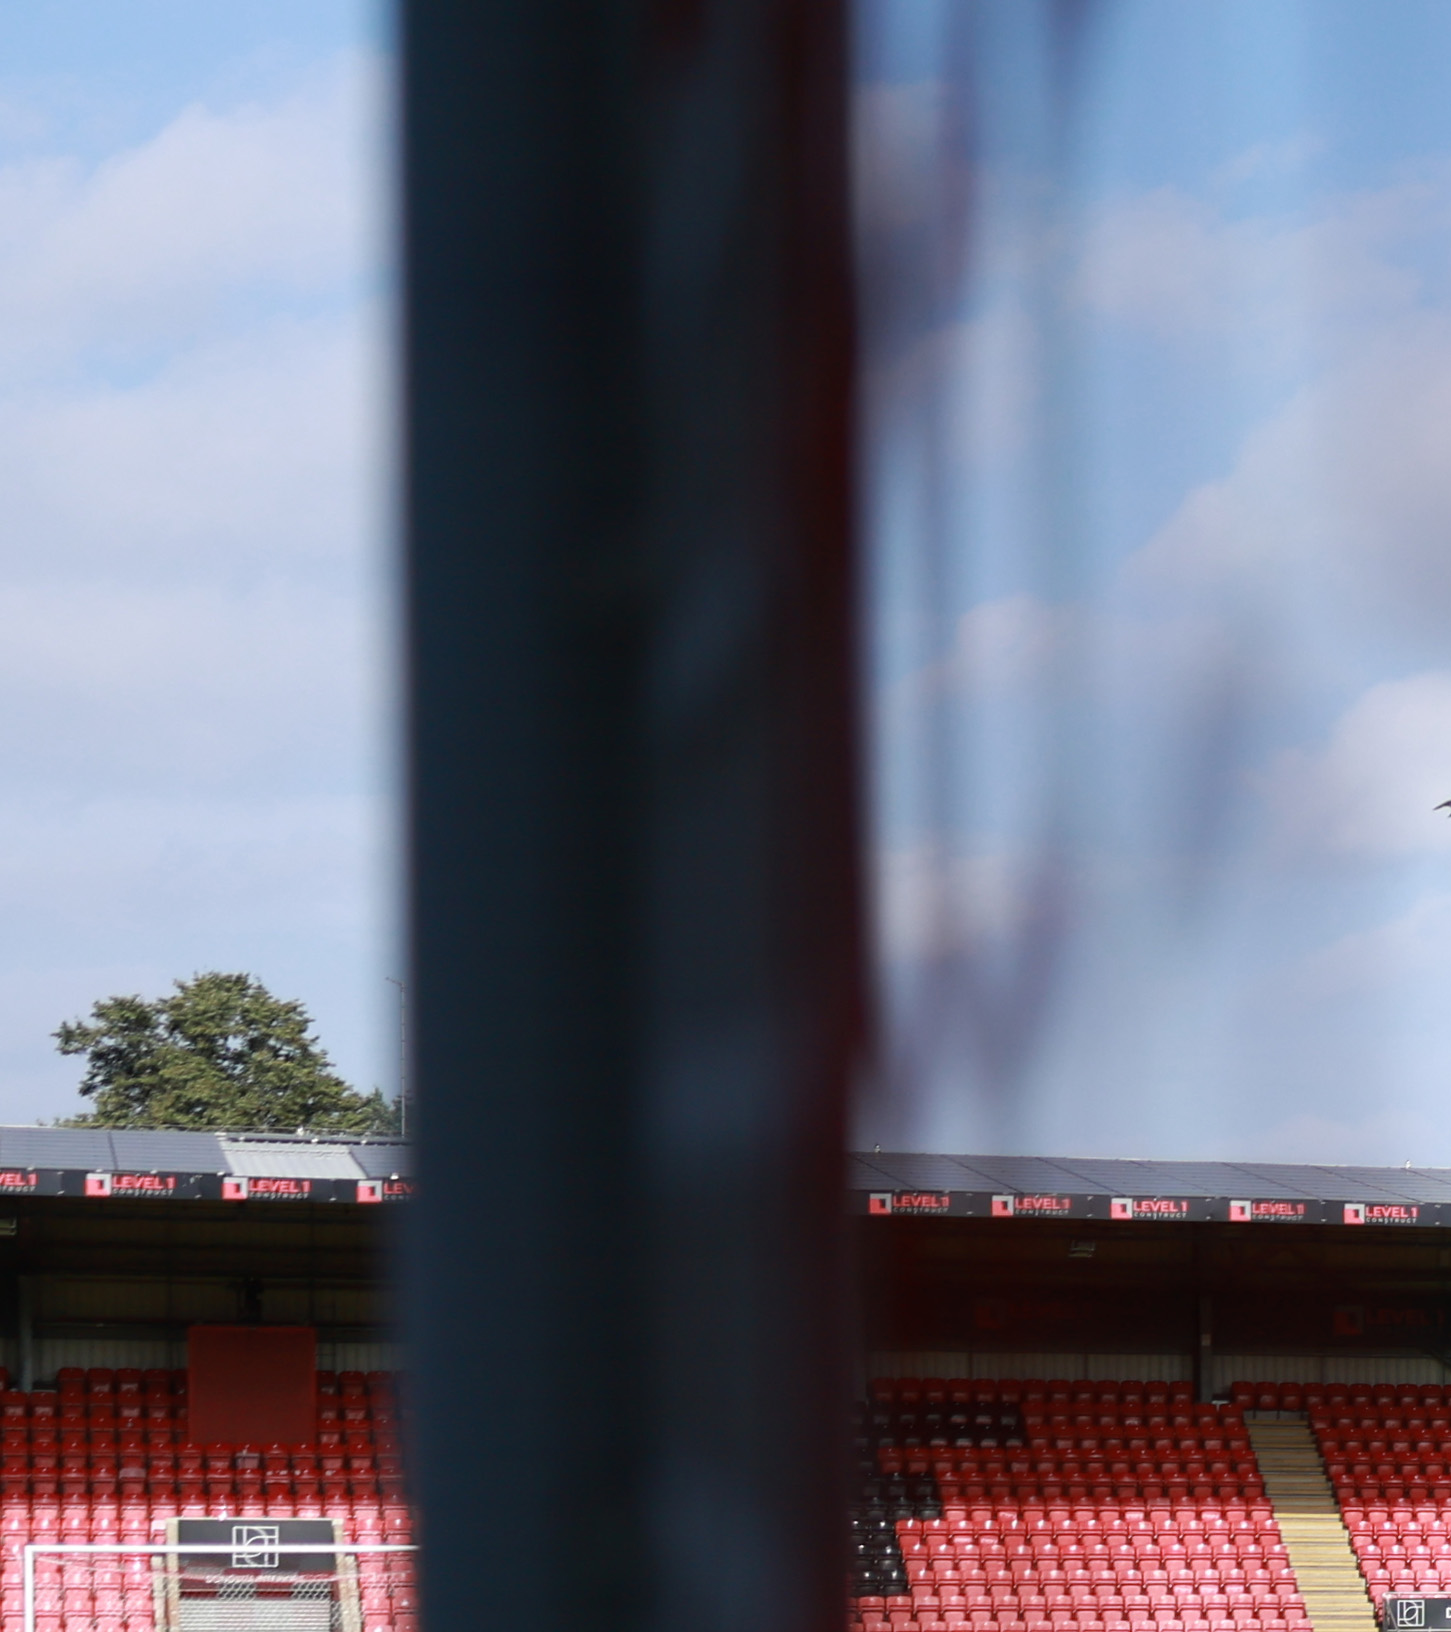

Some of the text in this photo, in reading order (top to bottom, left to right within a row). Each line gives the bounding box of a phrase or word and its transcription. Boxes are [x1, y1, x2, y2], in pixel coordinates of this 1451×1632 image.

[112, 1176, 176, 1189] LEVEL 1
[249, 1179, 310, 1193] LEVEL 1
[892, 1195, 950, 1207] LEVEL 1
[1014, 1198, 1070, 1210] LEVEL 1
[1133, 1201, 1188, 1213] LEVEL 1
[1252, 1203, 1305, 1215] LEVEL 1
[1365, 1206, 1418, 1218] LEVEL 1
